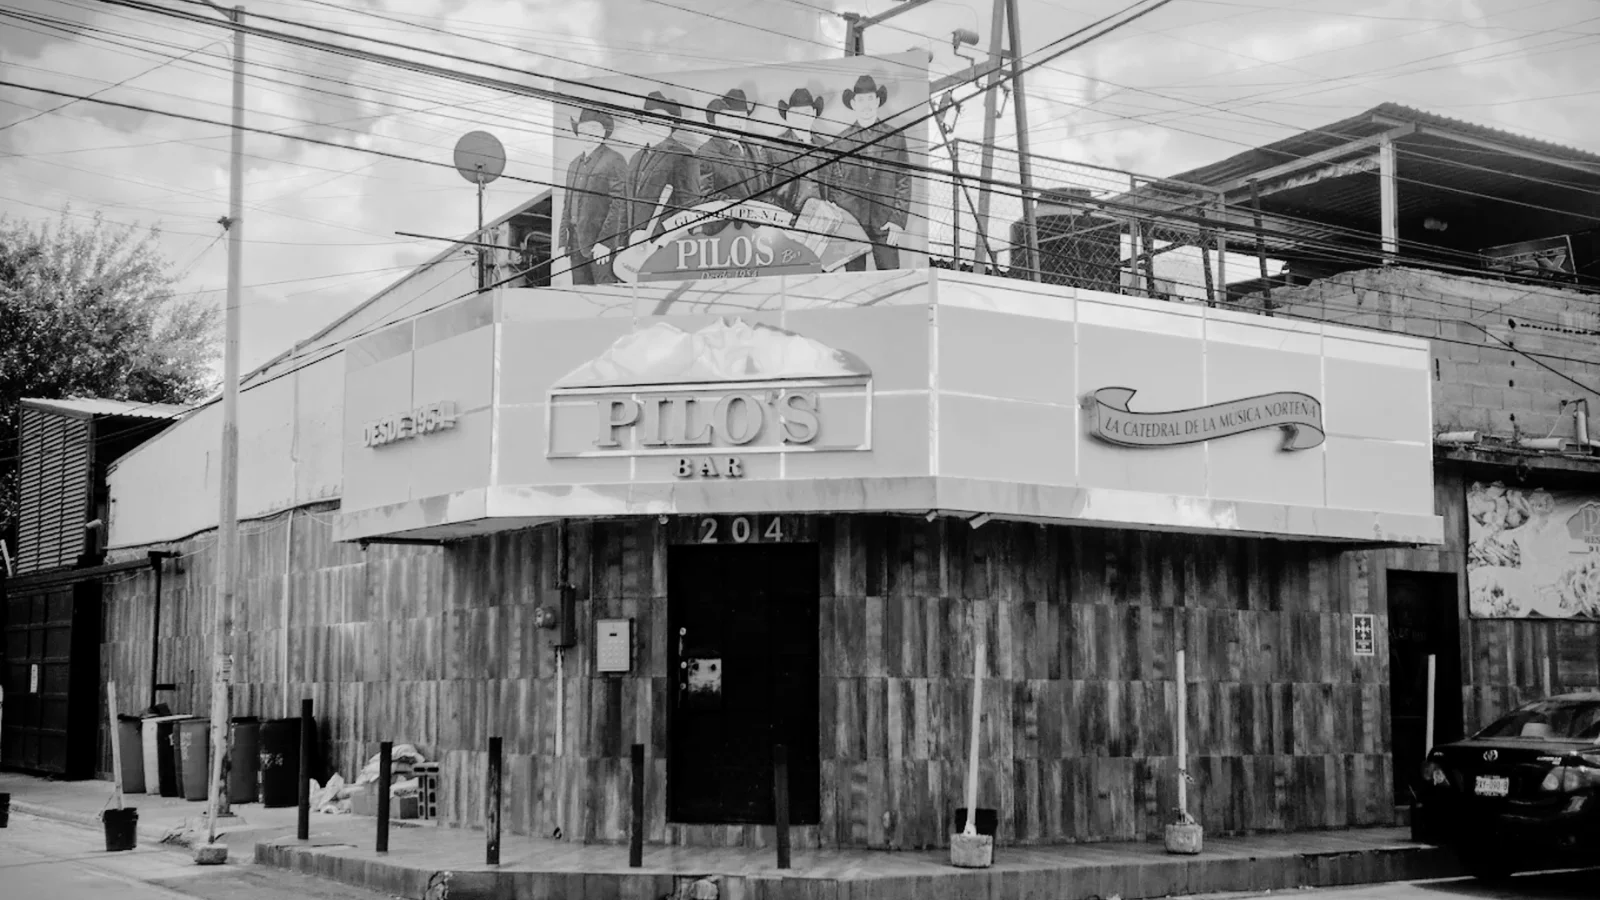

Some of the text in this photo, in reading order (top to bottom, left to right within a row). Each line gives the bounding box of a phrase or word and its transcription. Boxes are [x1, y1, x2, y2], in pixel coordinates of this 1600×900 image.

[676, 235, 775, 270] PILO'S
[363, 412, 415, 449] DESDE
[593, 391, 820, 449] PILO'S
[1105, 416, 1119, 434] LA
[1123, 420, 1182, 438] CATEDRAL
[1184, 418, 1200, 435] DE
[1202, 417, 1217, 433] LA
[1264, 398, 1317, 418] NORTEÑA
[673, 456, 745, 479] BAR
[700, 516, 784, 543] 204
